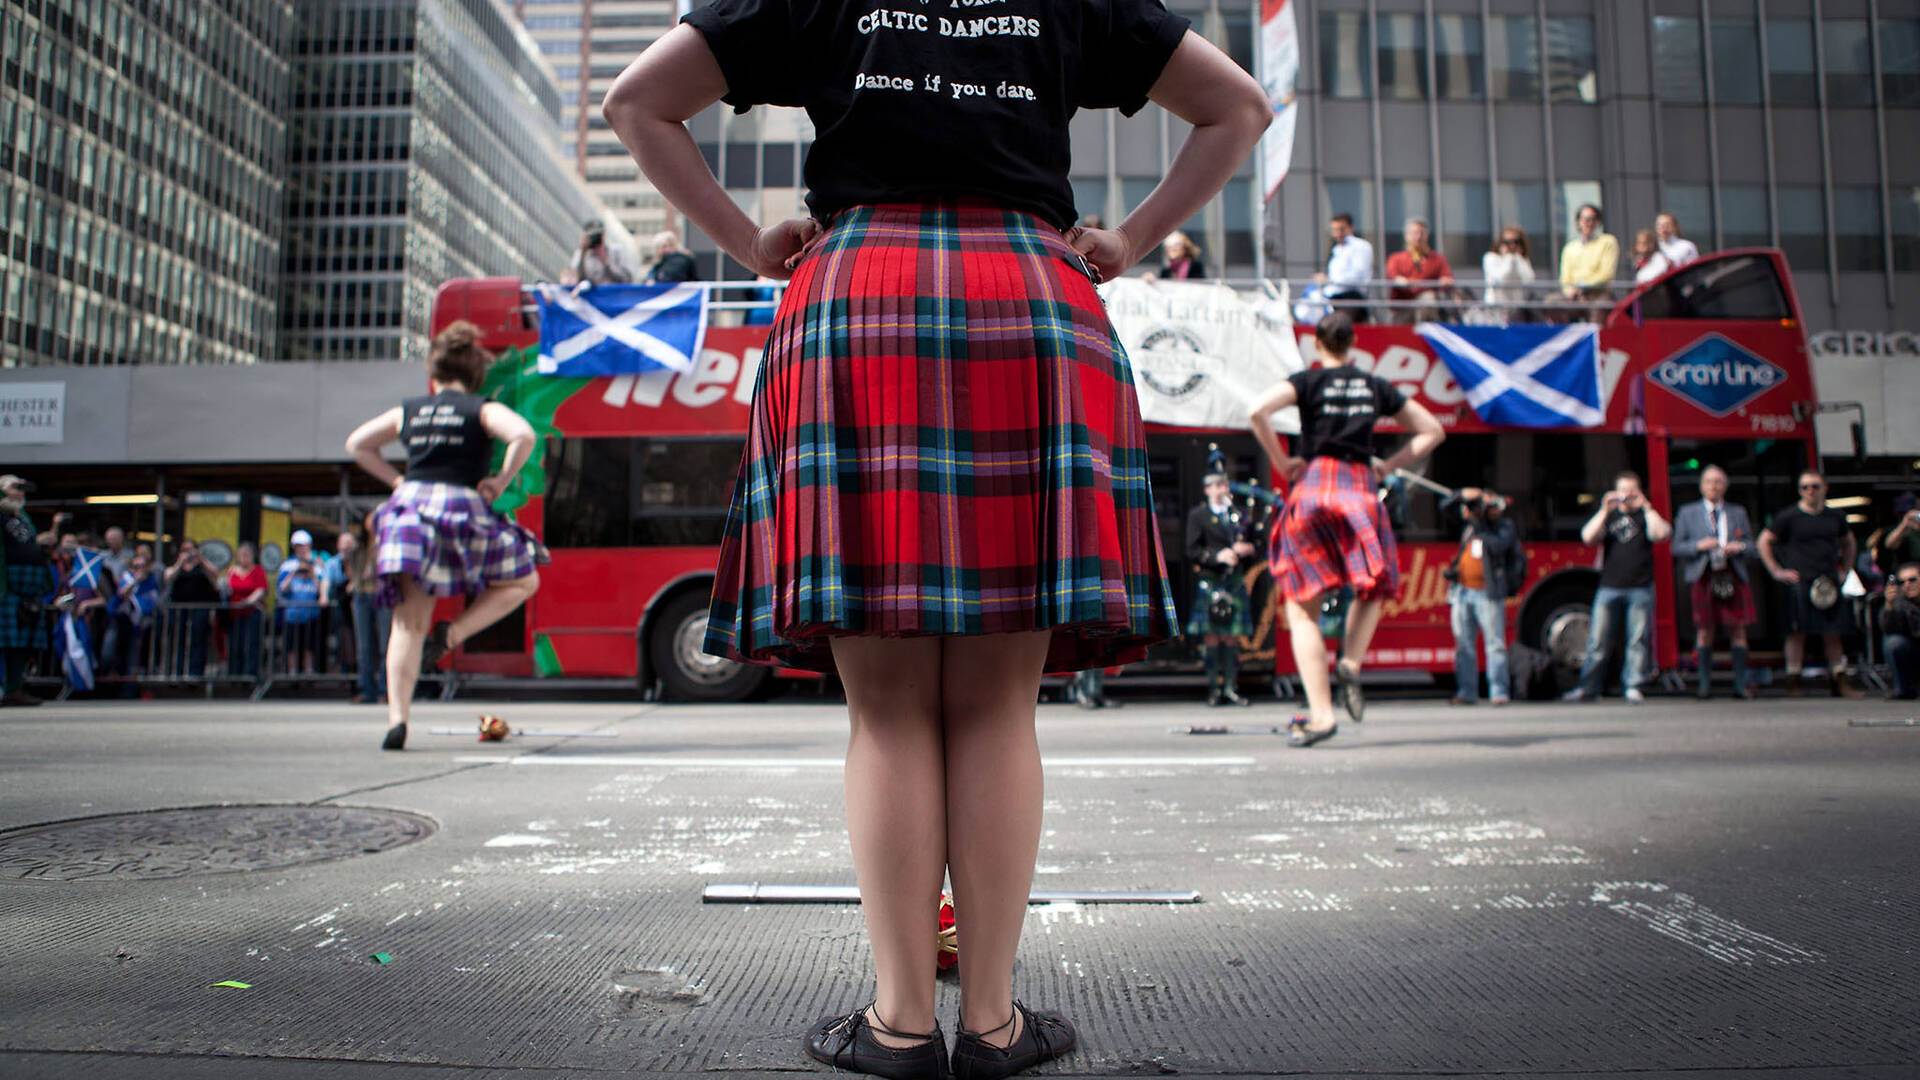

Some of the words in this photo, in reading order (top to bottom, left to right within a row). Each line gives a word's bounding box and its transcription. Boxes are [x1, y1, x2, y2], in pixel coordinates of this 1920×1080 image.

[857, 8, 928, 35] CELTIC
[939, 15, 1041, 38] DANCERS
[855, 72, 914, 92] Dance
[924, 73, 941, 93] if
[950, 81, 987, 100] you
[996, 80, 1037, 101] dare.
[1811, 330, 1920, 357] GRIC
[1660, 361, 1721, 386] Gray
[1723, 360, 1776, 386] Line
